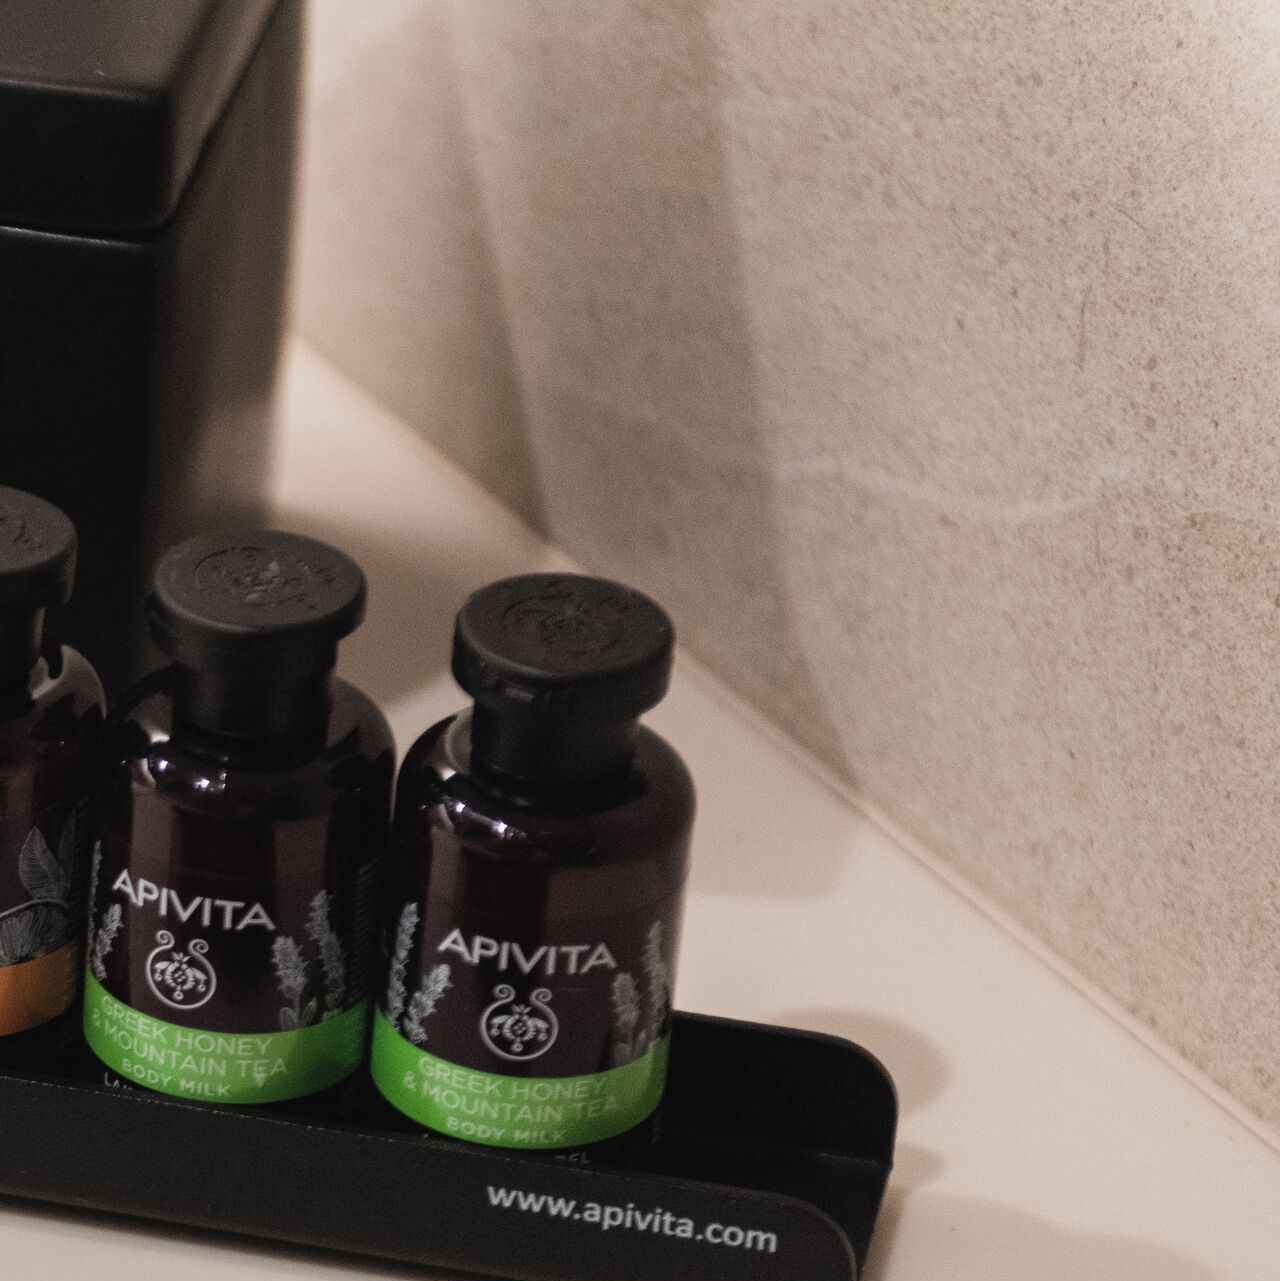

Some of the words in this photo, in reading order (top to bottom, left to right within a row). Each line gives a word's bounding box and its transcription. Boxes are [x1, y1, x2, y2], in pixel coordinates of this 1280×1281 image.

[112, 868, 277, 931] APIVITA
[438, 927, 618, 976] APIVITA
[102, 995, 168, 1043] GREEK
[175, 1031, 274, 1056] HONEY
[104, 1019, 227, 1077] MOUNTAIN
[239, 1058, 289, 1079] TEA
[121, 1058, 172, 1086] BODY
[180, 1079, 233, 1098] MILK
[418, 1055, 503, 1098] GREEK
[511, 1079, 606, 1102] HONEY
[420, 1083, 564, 1122] MOUNTAIN
[570, 1096, 618, 1119] TEA
[446, 1115, 507, 1141] BODY
[510, 1128, 568, 1145] MILK
[486, 1185, 779, 1255] www.apivita.com
